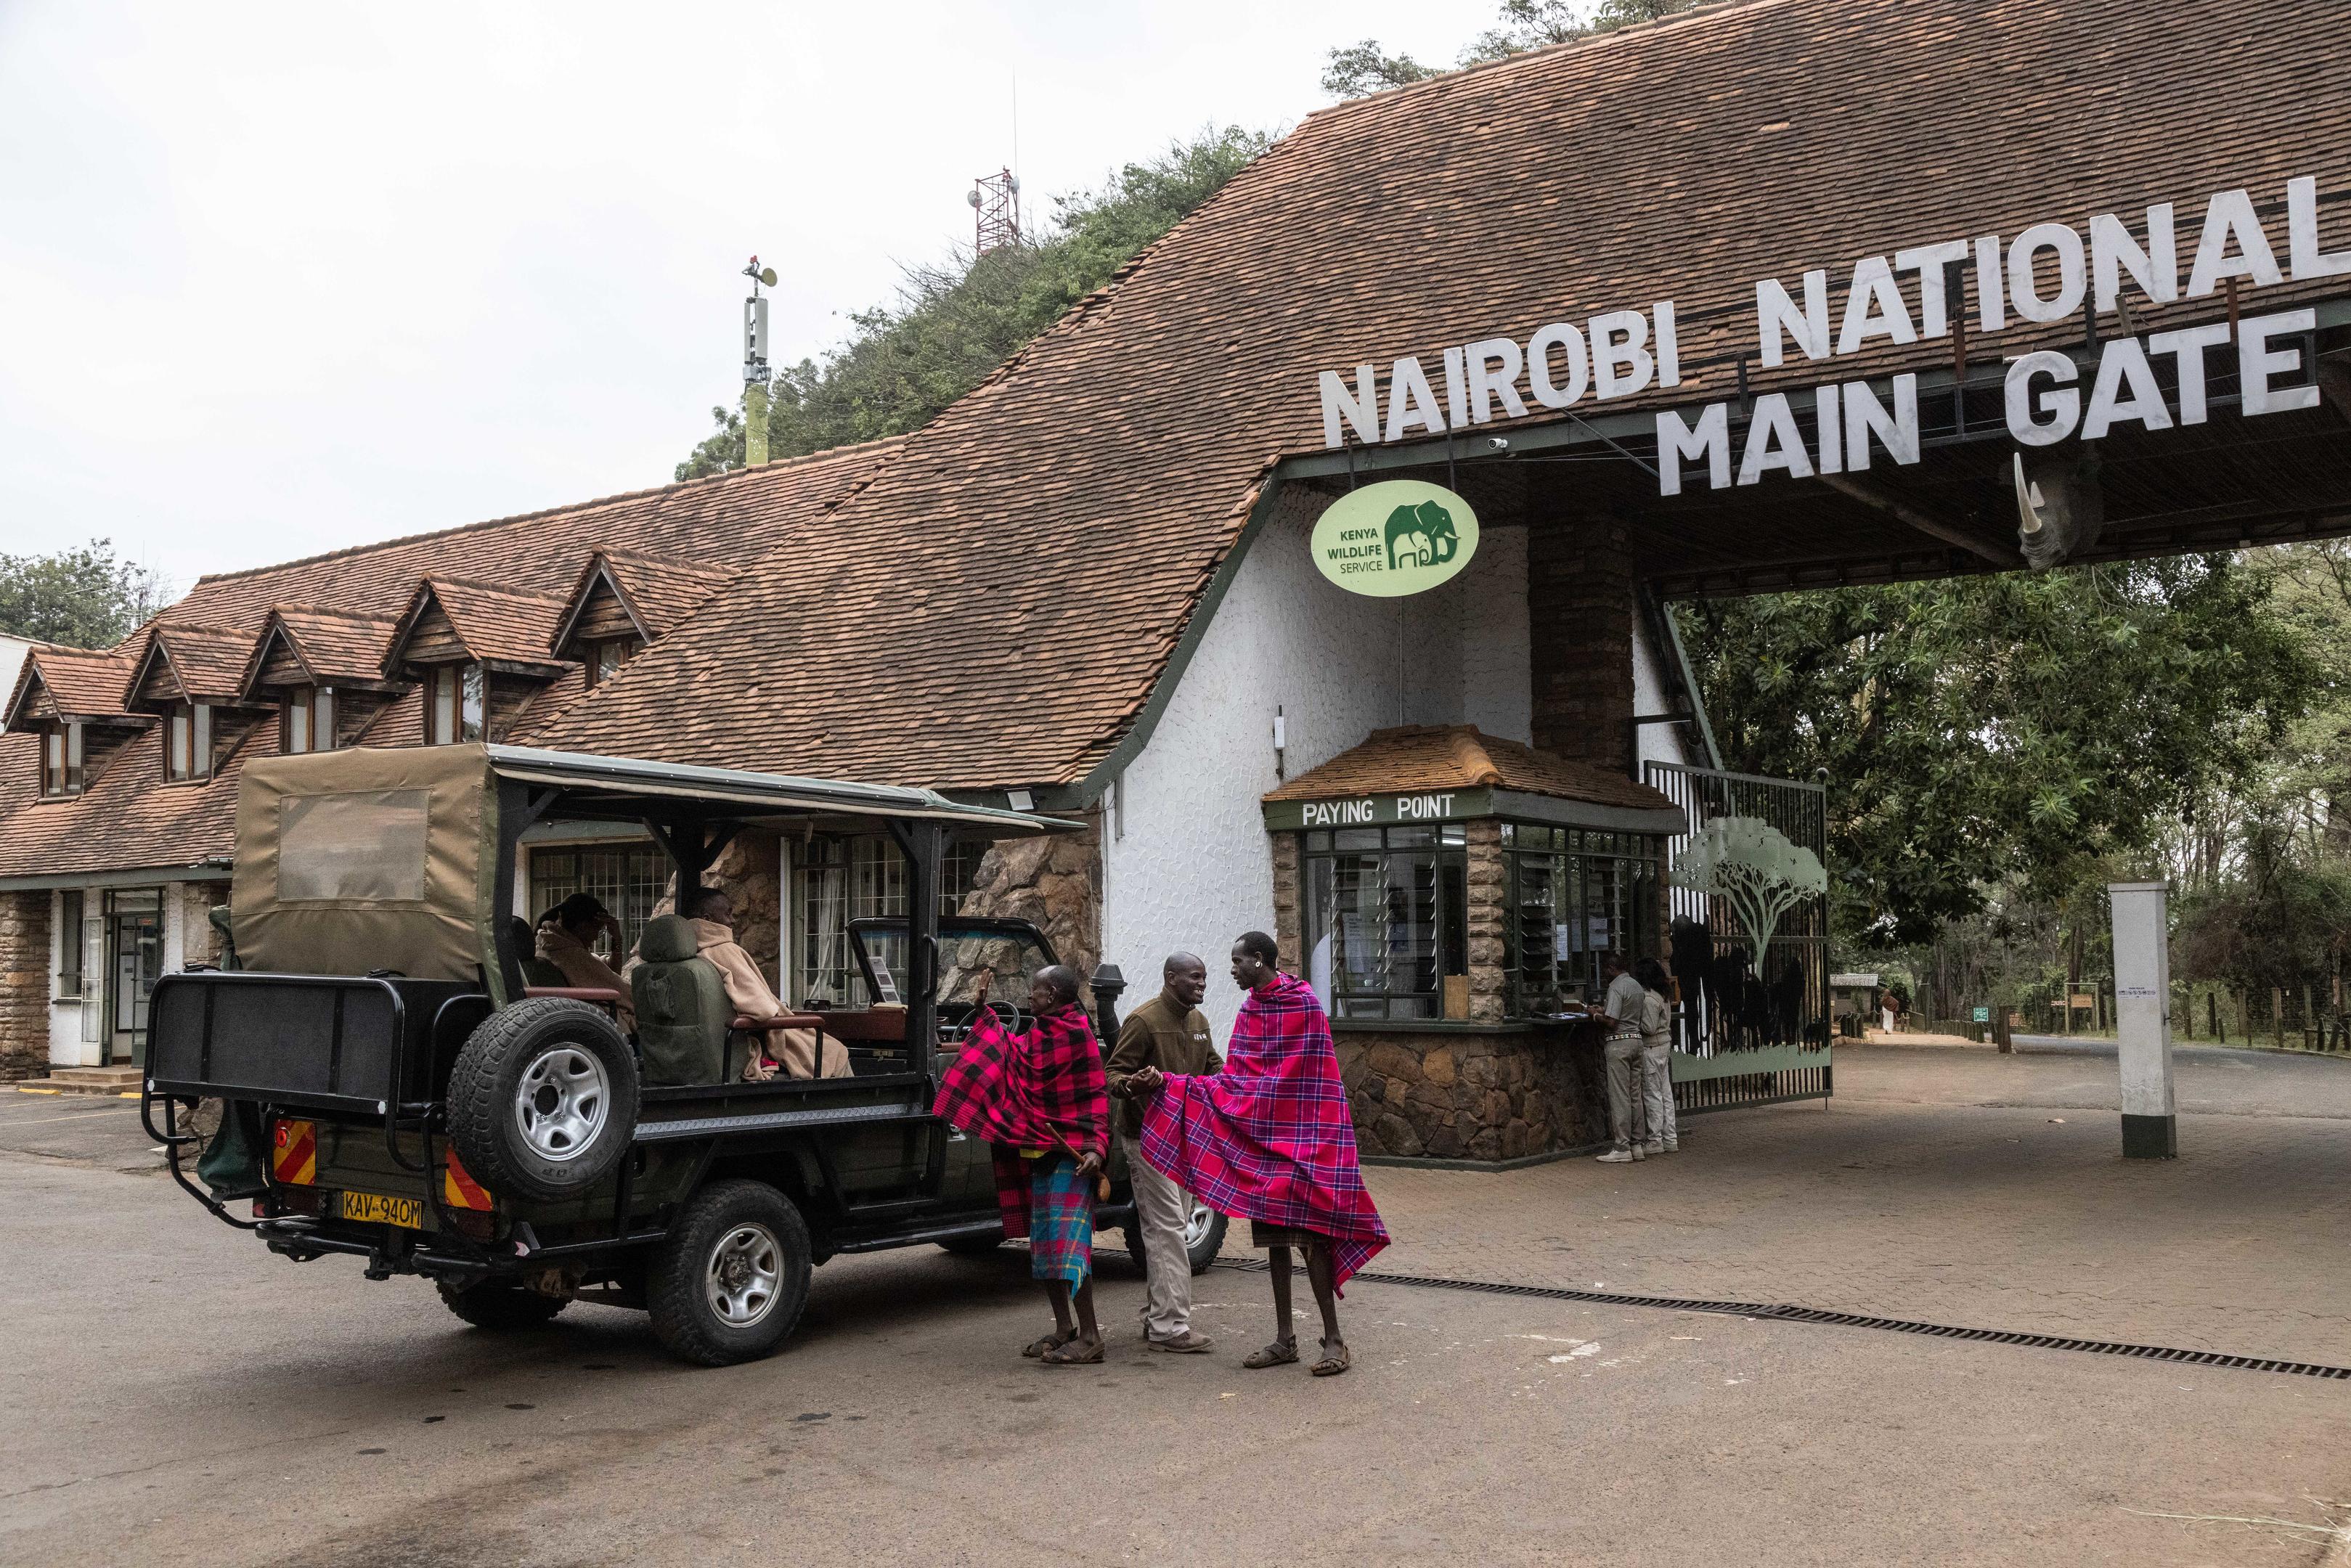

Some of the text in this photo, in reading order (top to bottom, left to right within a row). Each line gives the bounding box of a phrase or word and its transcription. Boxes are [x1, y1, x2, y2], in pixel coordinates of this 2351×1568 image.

[1319, 176, 2351, 449] NAIROBI NATIONAL
[1656, 308, 2321, 496] MAIN GATE
[1340, 528, 1378, 541] KENYA
[1327, 544, 1382, 560] WILDLIFE
[1340, 560, 1382, 573] SERVICE
[1303, 793, 1455, 825] PAYING POINT
